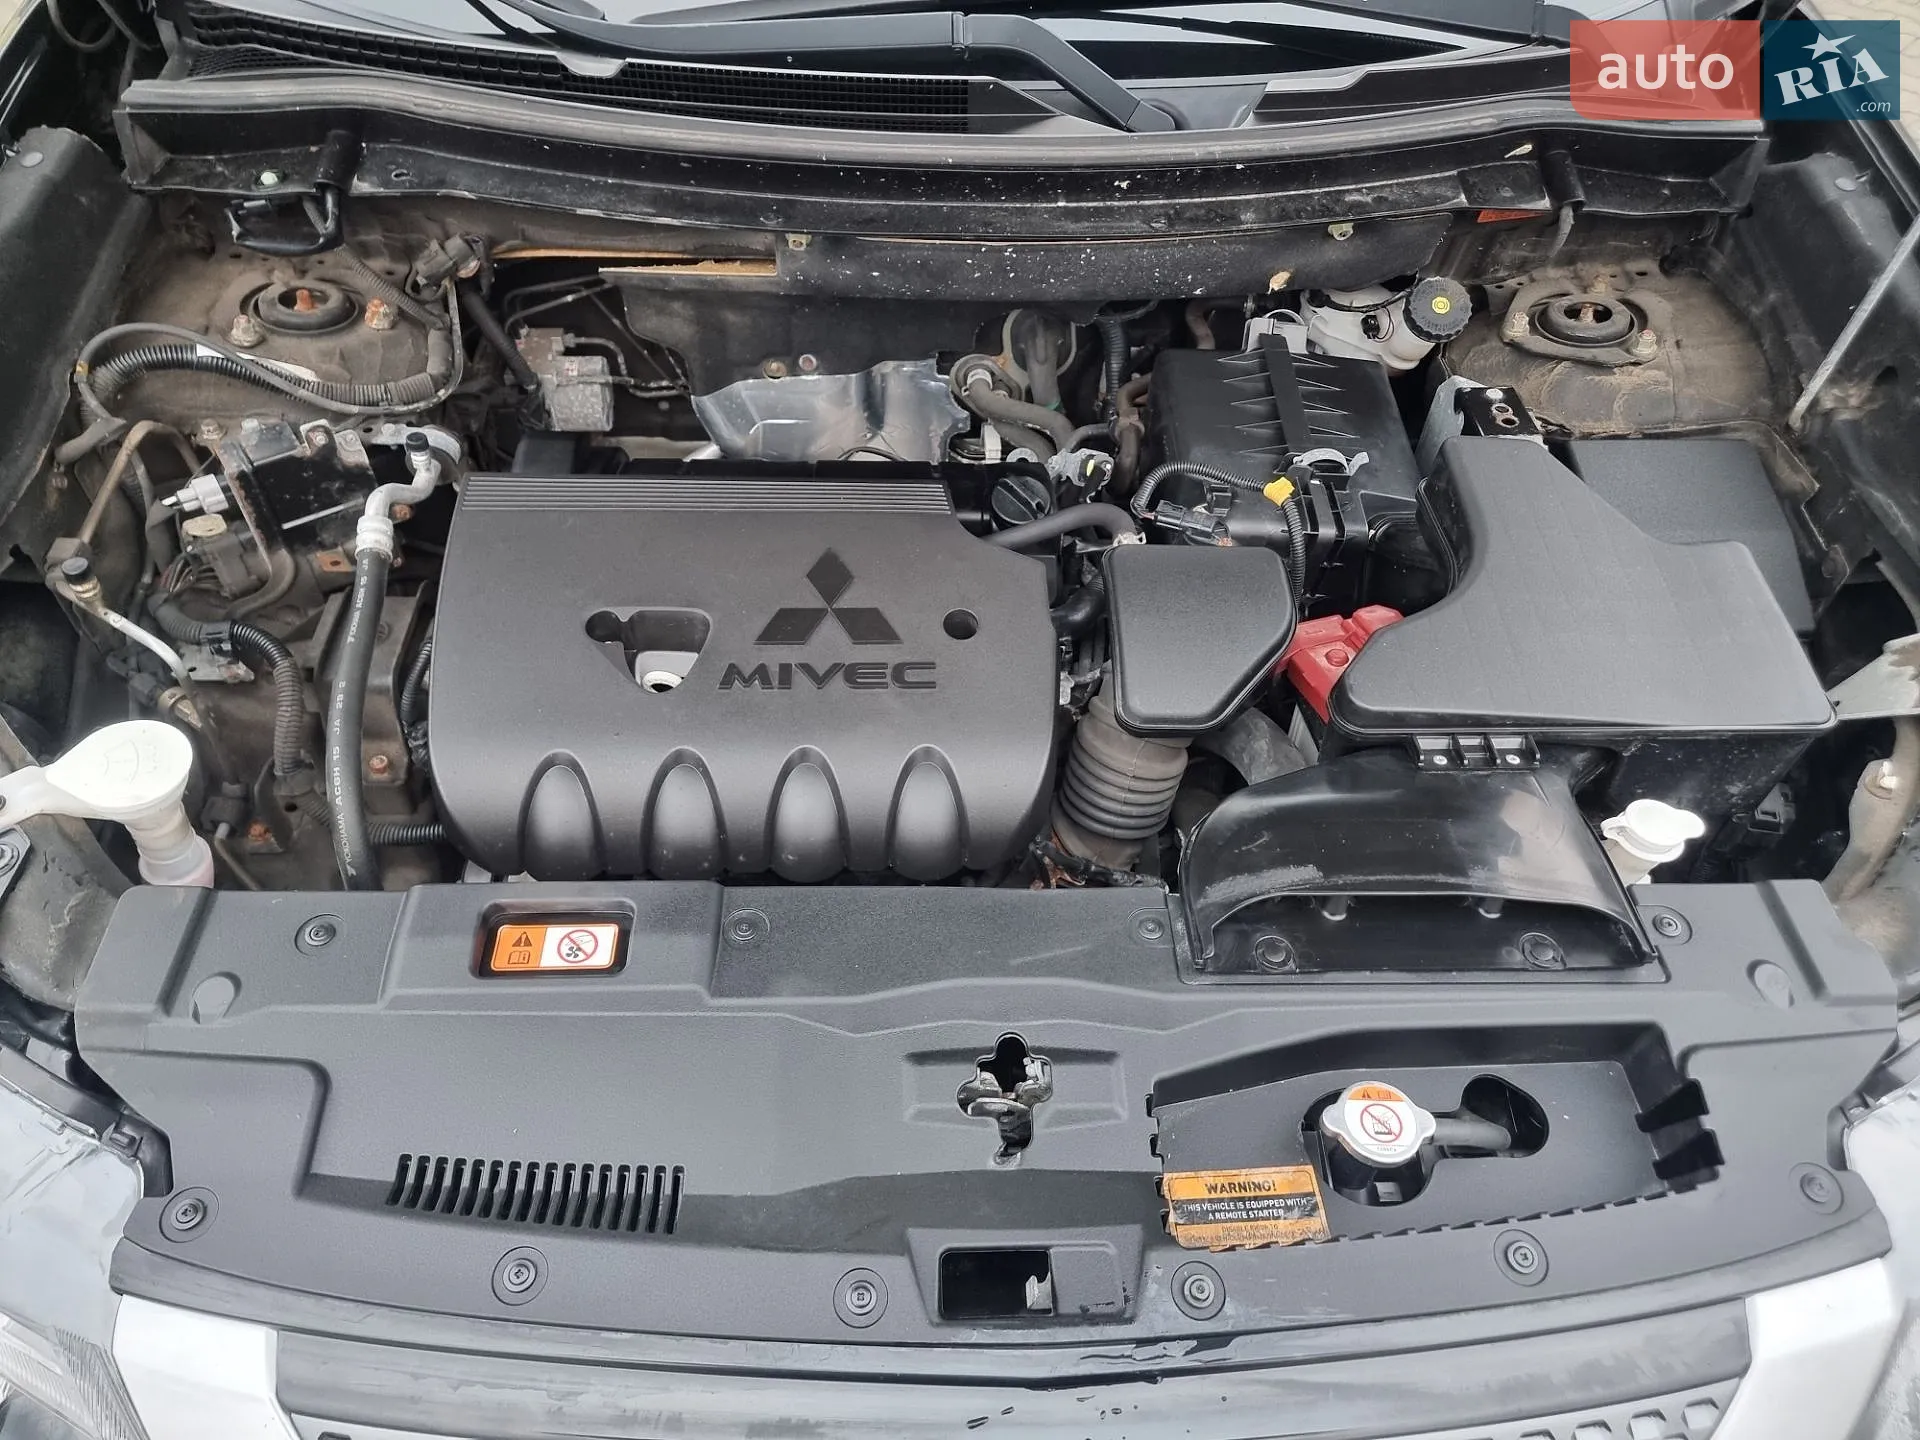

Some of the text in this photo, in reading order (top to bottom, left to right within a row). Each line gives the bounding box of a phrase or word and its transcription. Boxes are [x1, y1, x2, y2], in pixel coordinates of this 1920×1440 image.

[718, 661, 937, 690] MIVEC
[333, 719, 341, 735] JA
[332, 745, 341, 761] 15
[336, 812, 352, 864] YOKOHAMA
[1205, 1180, 1277, 1194] WARNING!
[1202, 1202, 1236, 1211] VEHICLE
[1236, 1201, 1245, 1209] IS
[1246, 1199, 1285, 1209] EQUIPPED
[1285, 1198, 1308, 1207] WITH
[1215, 1211, 1248, 1220] REMOTE
[1249, 1208, 1284, 1218] STARTER
